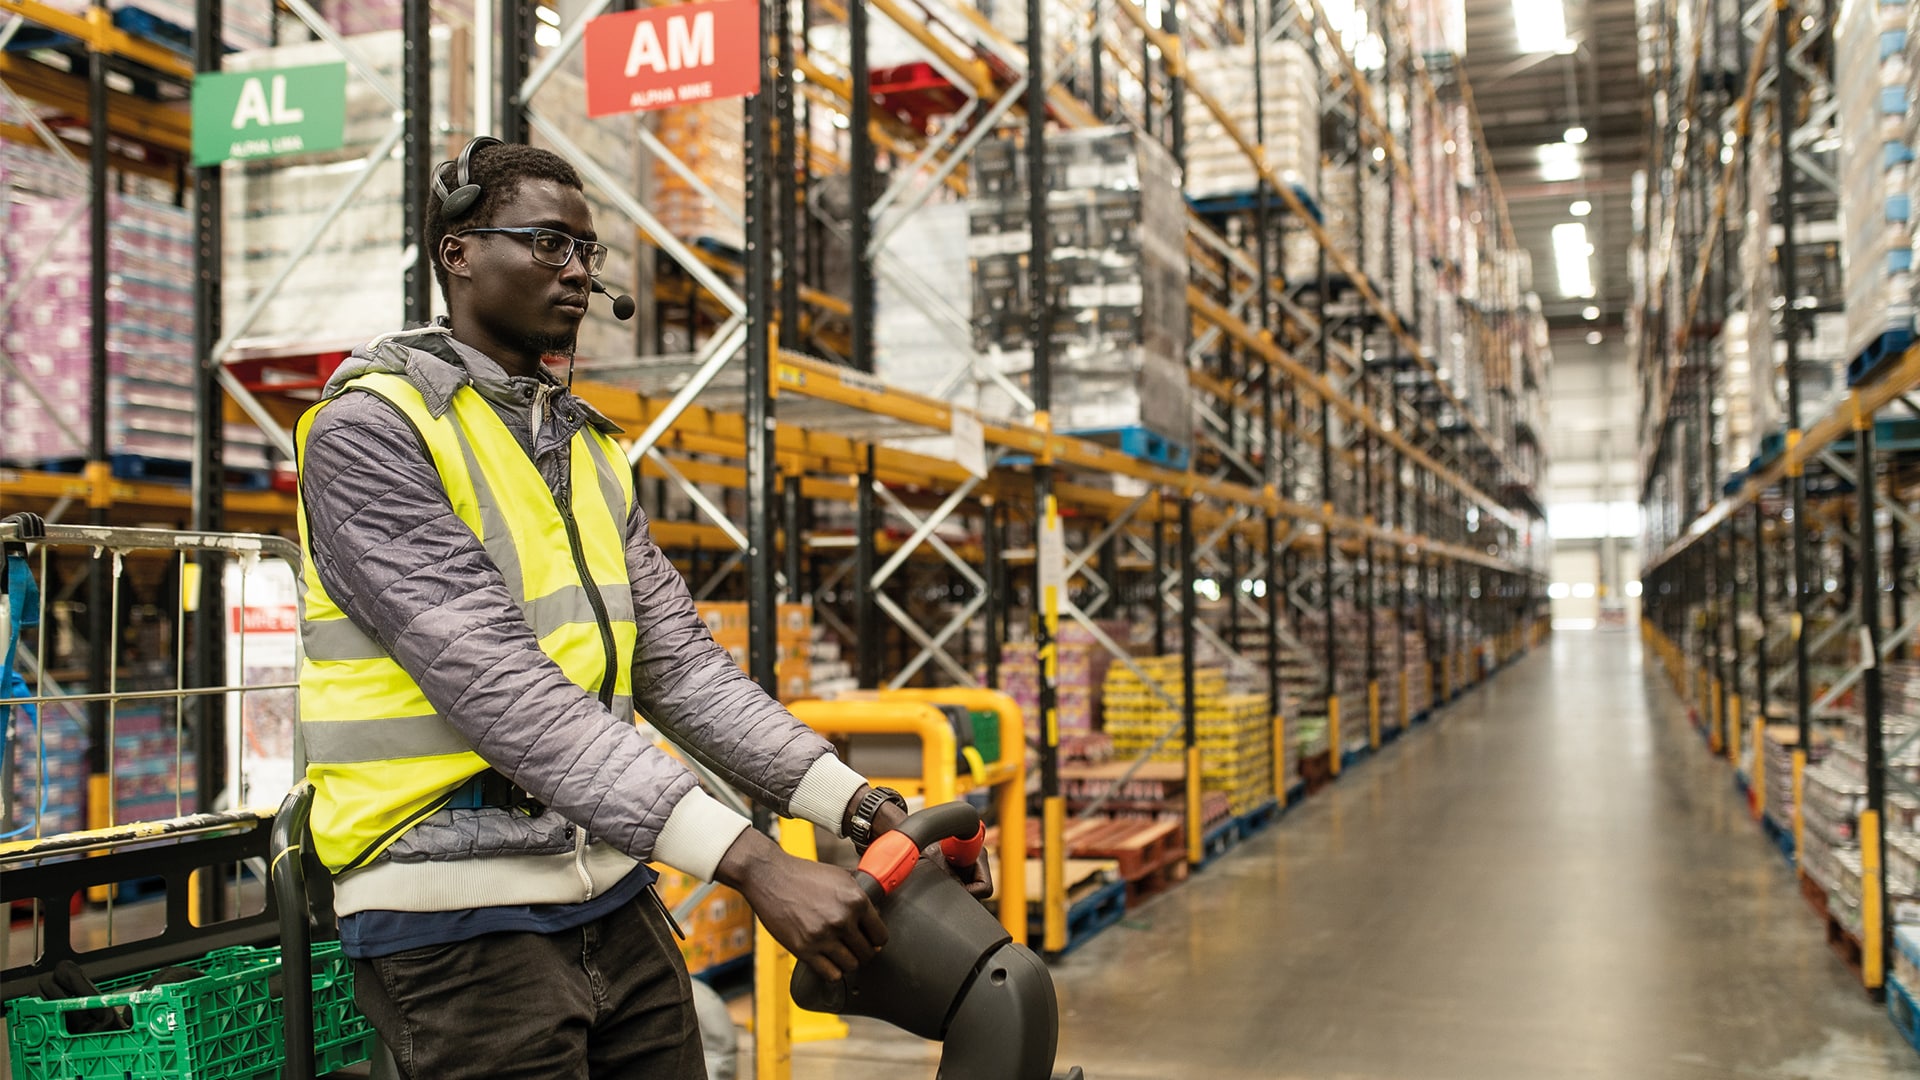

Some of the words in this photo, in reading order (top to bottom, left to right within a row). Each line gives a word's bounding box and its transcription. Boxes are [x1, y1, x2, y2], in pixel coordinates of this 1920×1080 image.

[624, 11, 714, 77] AM
[231, 75, 304, 129] AL
[630, 87, 675, 107] ALPHA
[678, 81, 712, 100] MIKE
